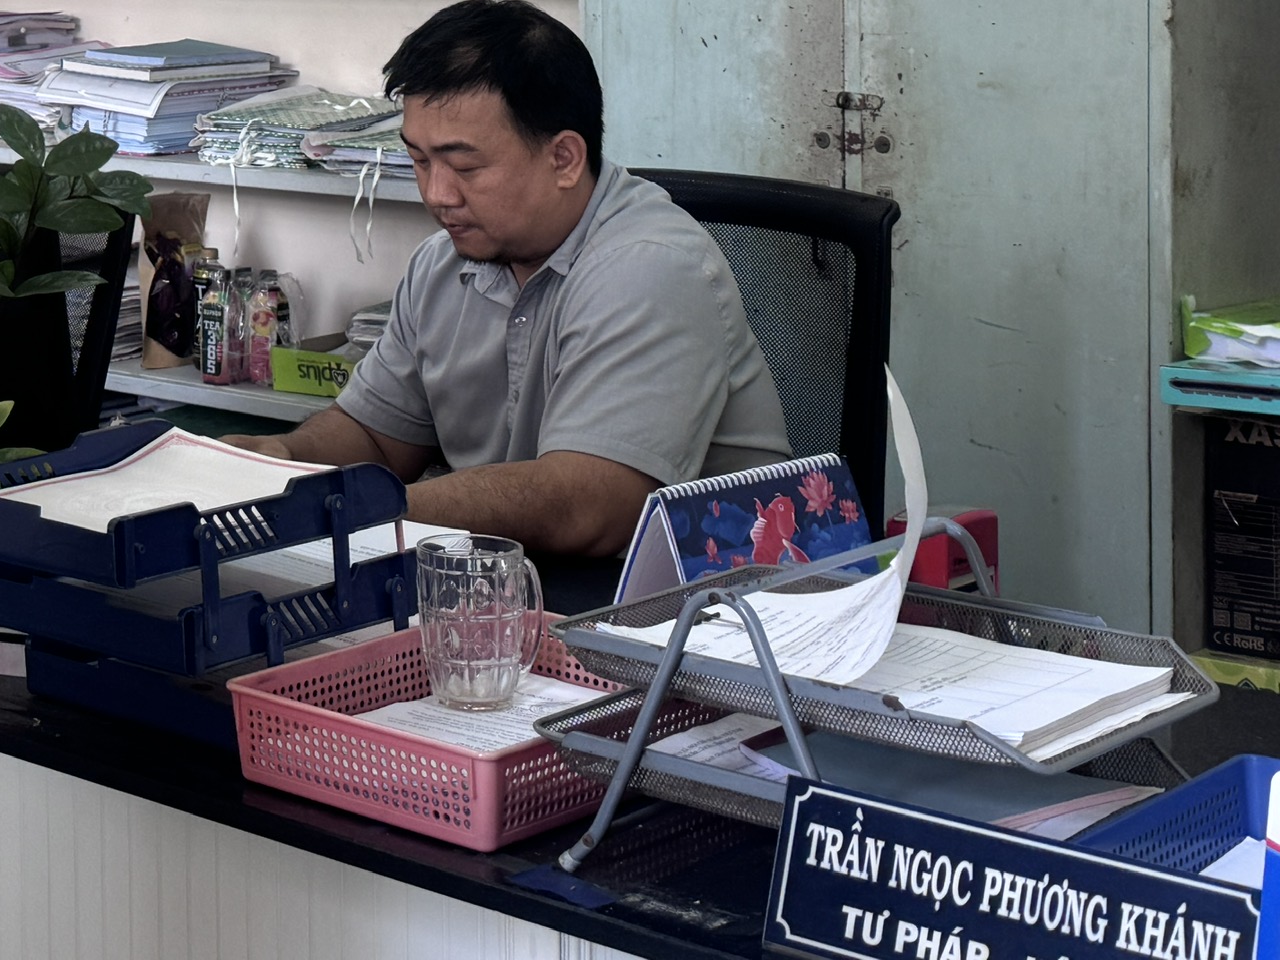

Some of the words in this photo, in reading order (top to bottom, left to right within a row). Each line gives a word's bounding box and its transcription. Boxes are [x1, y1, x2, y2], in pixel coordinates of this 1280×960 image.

[297, 361, 333, 386] plus
[805, 806, 885, 883] TRẦN
[887, 843, 974, 912] NGỌC
[978, 866, 1109, 944] PHƯƠNG
[1115, 902, 1241, 960] KHÁNH
[841, 905, 891, 946] TƯ
